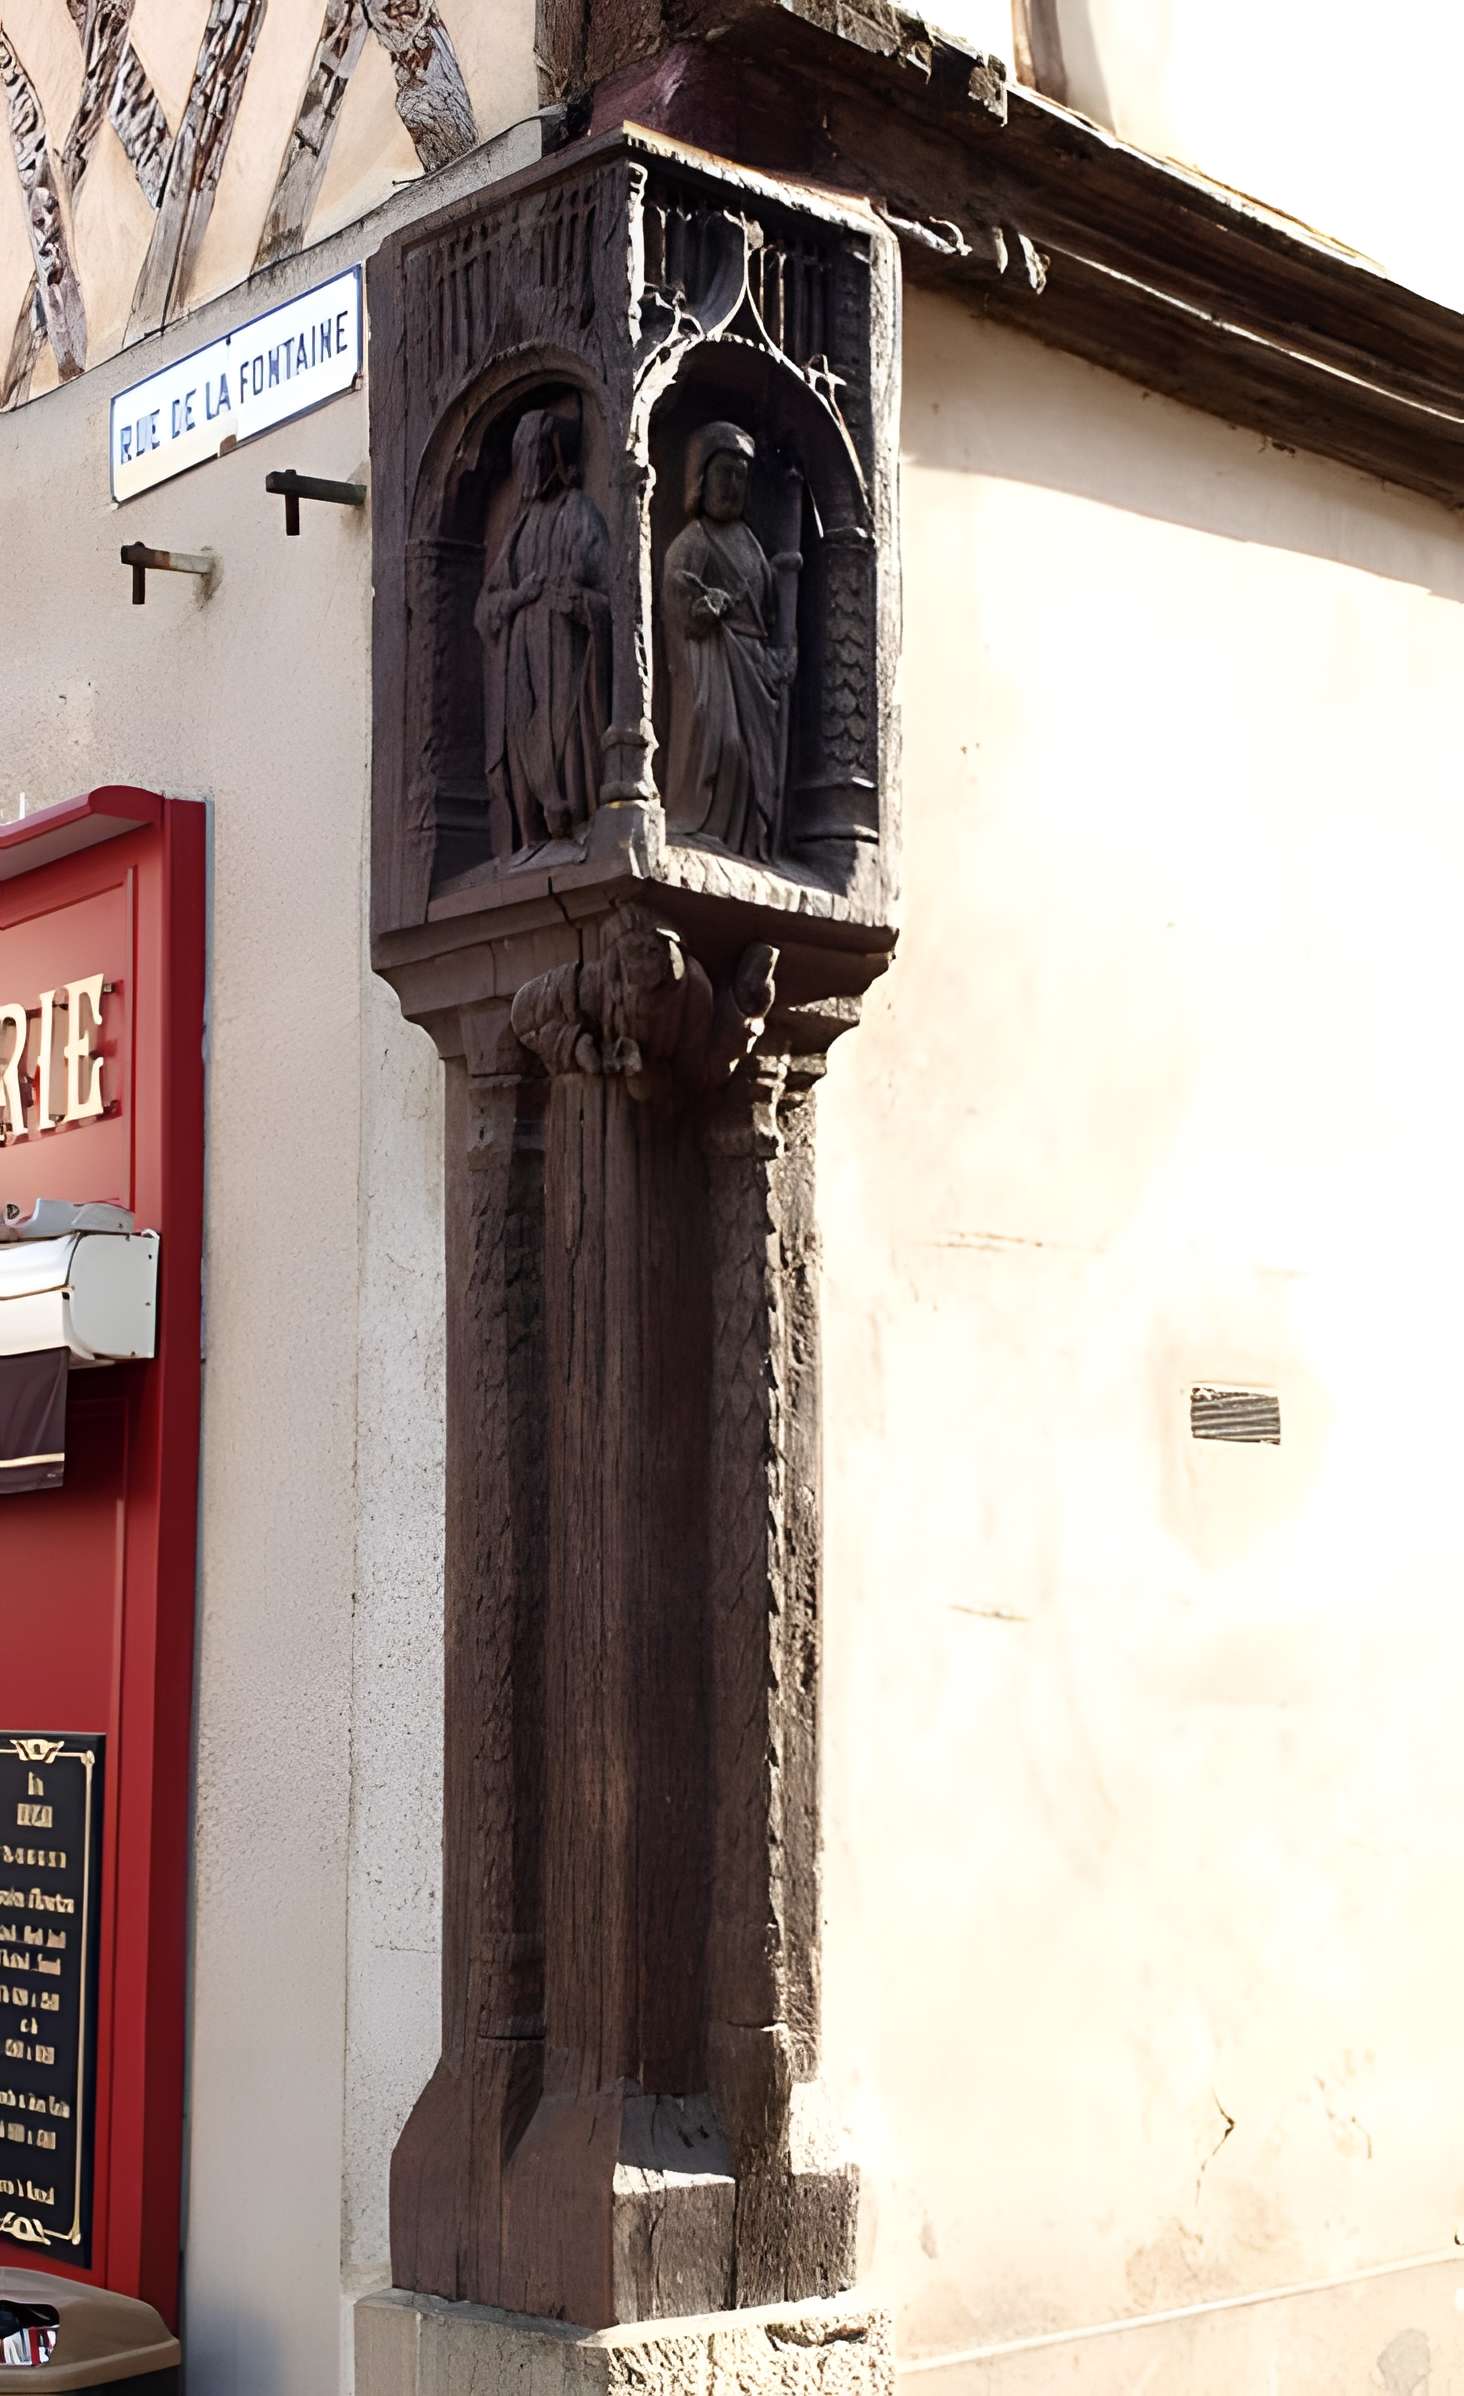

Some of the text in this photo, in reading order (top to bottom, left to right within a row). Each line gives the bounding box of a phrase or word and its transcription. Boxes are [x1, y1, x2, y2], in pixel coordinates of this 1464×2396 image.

[120, 310, 348, 465] RUE DE LA FONTAINE
